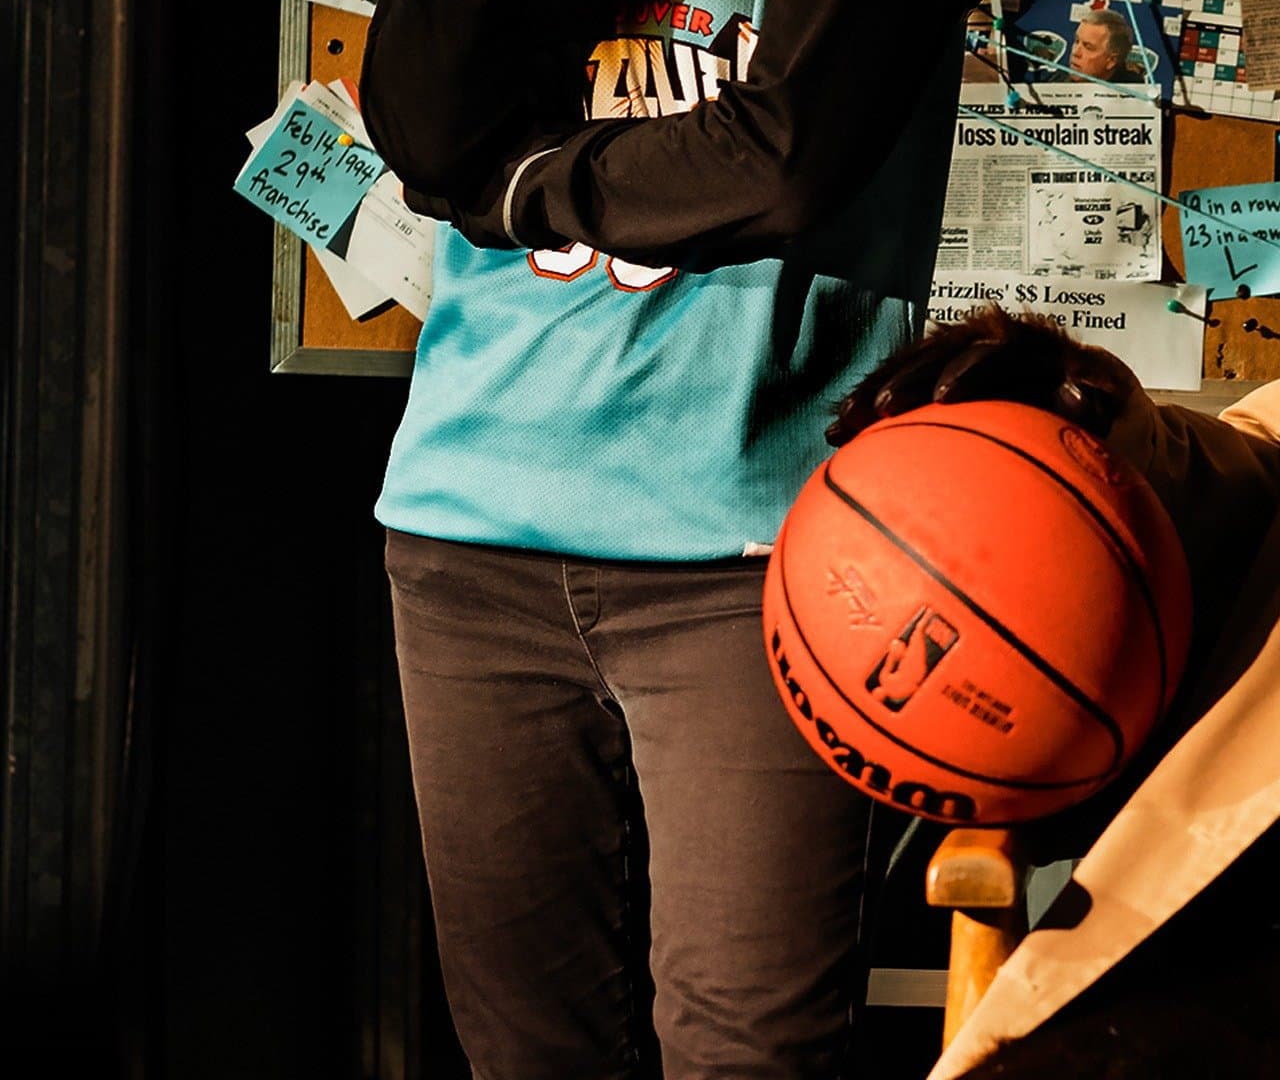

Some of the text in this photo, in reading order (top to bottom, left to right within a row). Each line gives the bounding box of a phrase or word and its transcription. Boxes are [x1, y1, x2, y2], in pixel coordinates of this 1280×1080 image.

[958, 122, 1153, 149] loss to explain streak
[282, 110, 376, 186] Feb 1994
[273, 150, 326, 189] 29th
[249, 167, 330, 240] franchise
[1074, 203, 1112, 212] GRIZZLIES
[1207, 199, 1225, 215] in
[1231, 201, 1241, 214] a
[1083, 236, 1102, 245] JAZZ
[1185, 224, 1212, 248] 23
[1216, 229, 1234, 245] in
[1224, 245, 1258, 281] L
[1015, 283, 1038, 304] $$
[1043, 285, 1106, 306] Losses
[1071, 311, 1126, 330] Fined
